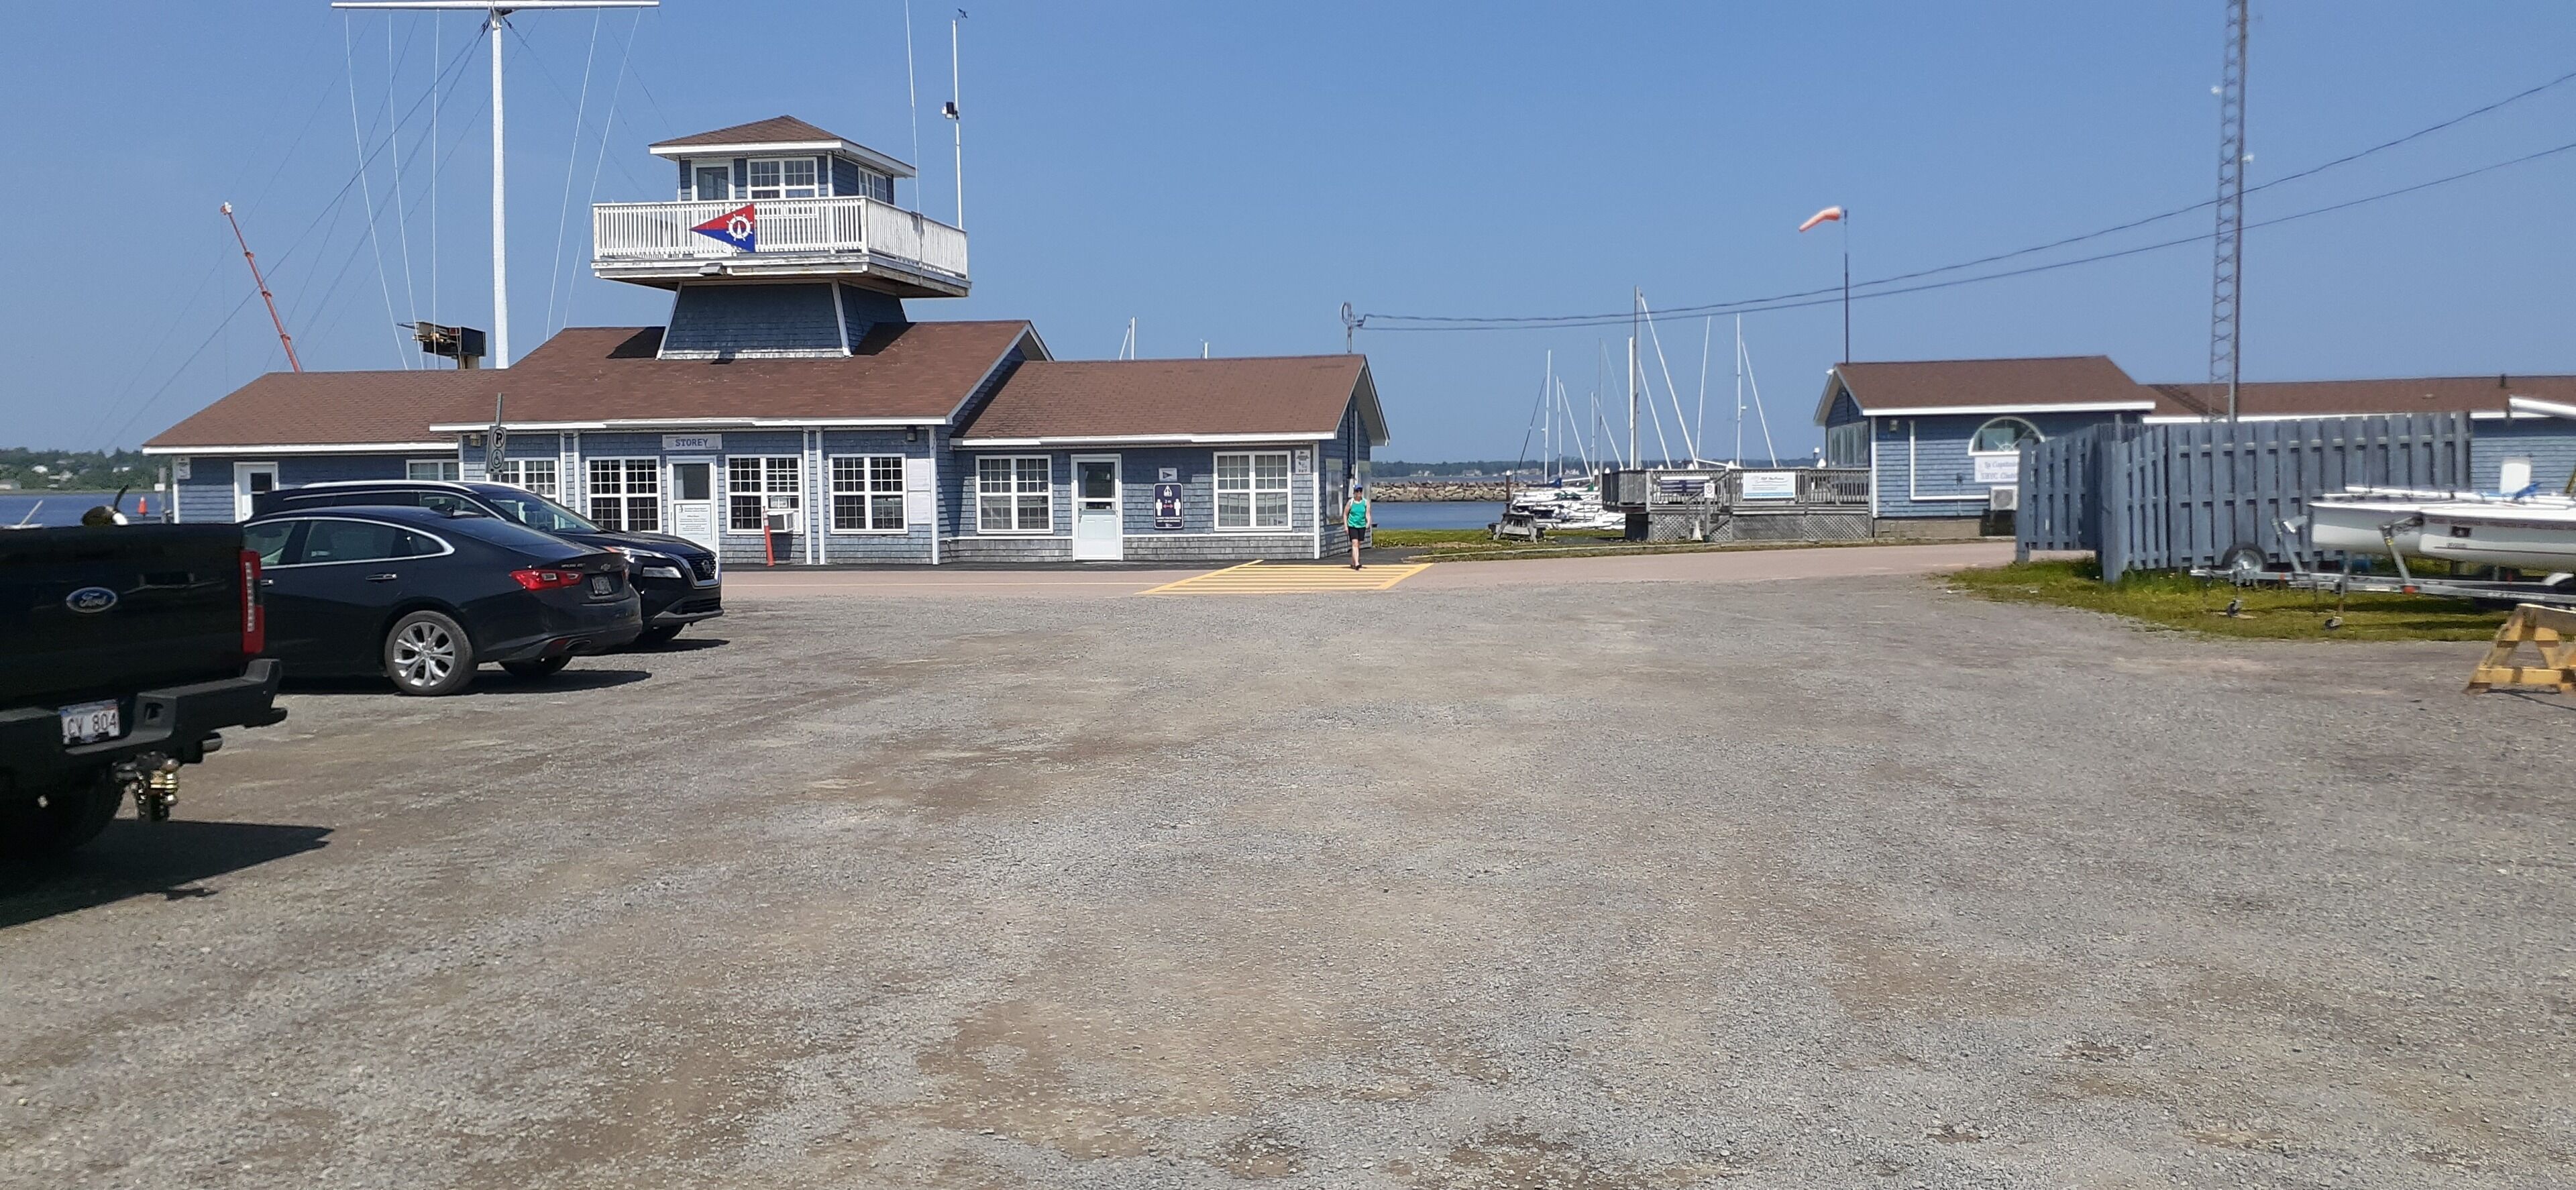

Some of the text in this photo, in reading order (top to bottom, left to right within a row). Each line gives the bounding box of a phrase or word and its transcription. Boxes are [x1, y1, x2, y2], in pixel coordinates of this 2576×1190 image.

[675, 438, 708, 447] STOREY
[79, 592, 108, 607] Ford
[93, 712, 117, 733] 804
